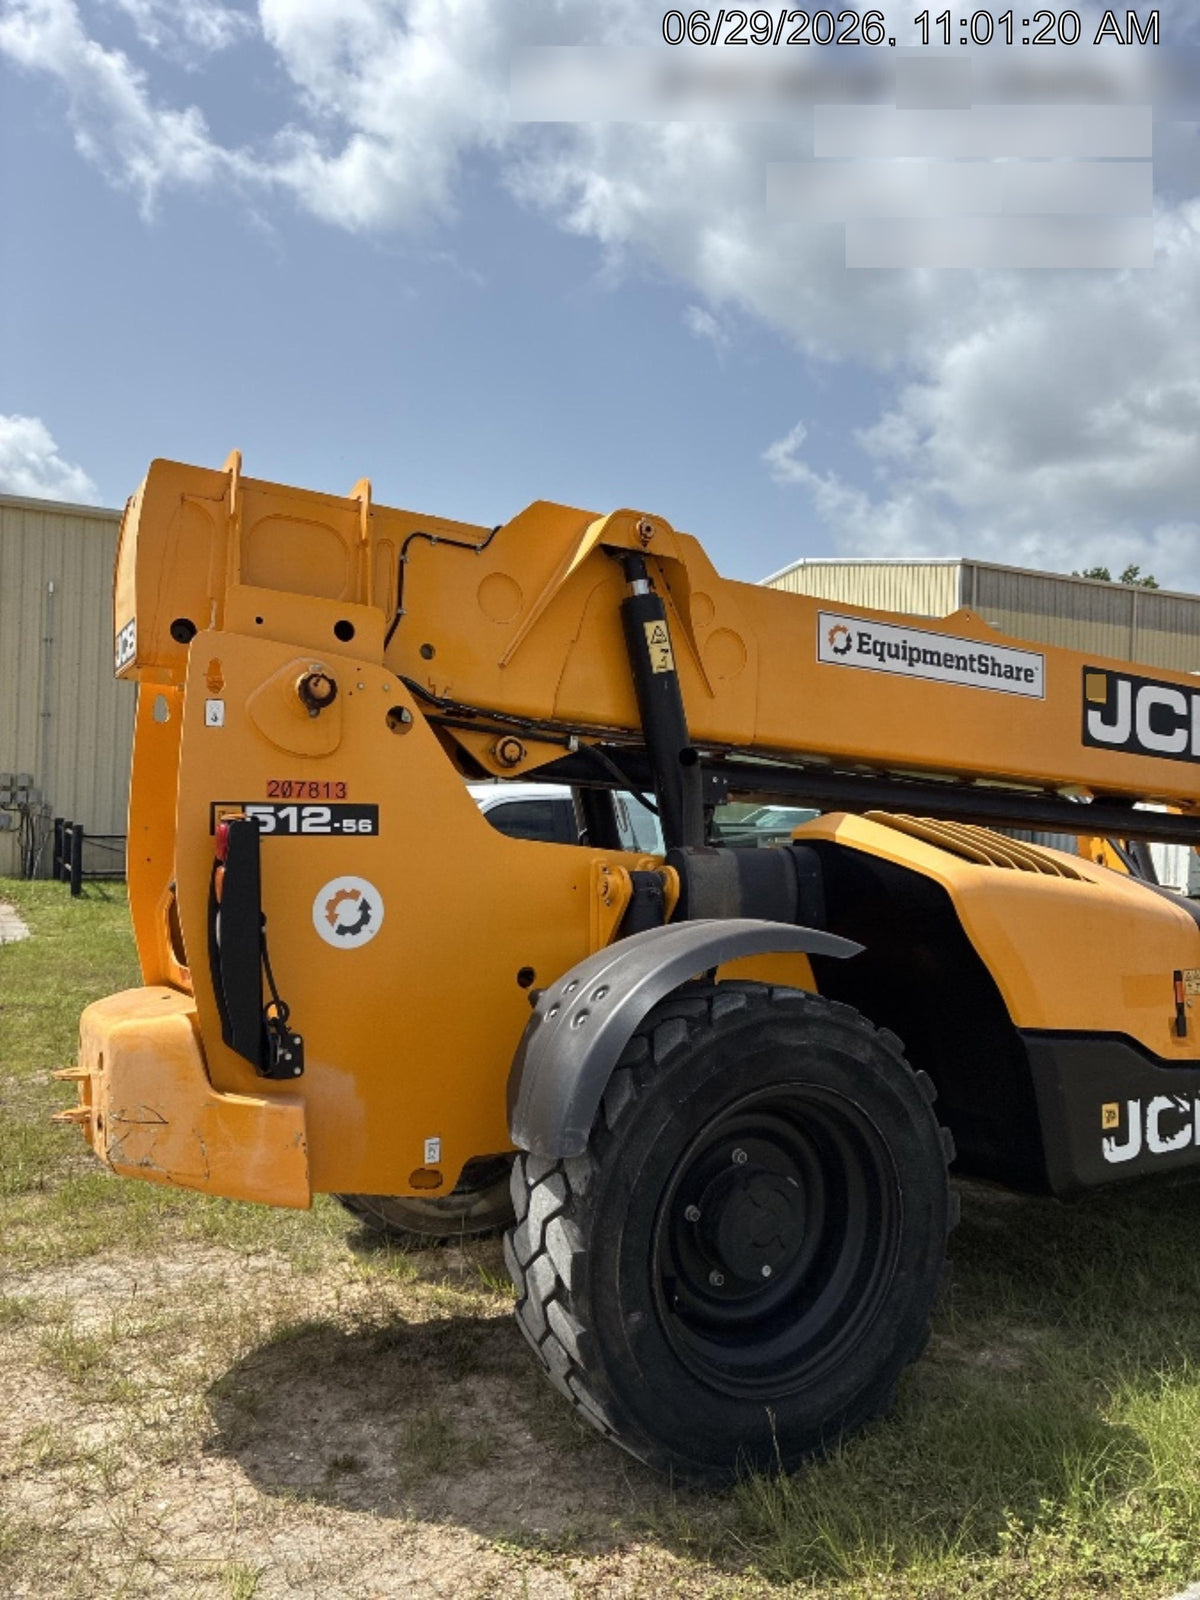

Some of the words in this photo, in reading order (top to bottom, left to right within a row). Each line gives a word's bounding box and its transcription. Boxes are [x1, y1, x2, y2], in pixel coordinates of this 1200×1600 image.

[856, 632, 1036, 684] EquipmentShare
[1087, 680, 1200, 757] JC
[267, 780, 347, 799] 207813
[1102, 1095, 1200, 1163] JC
